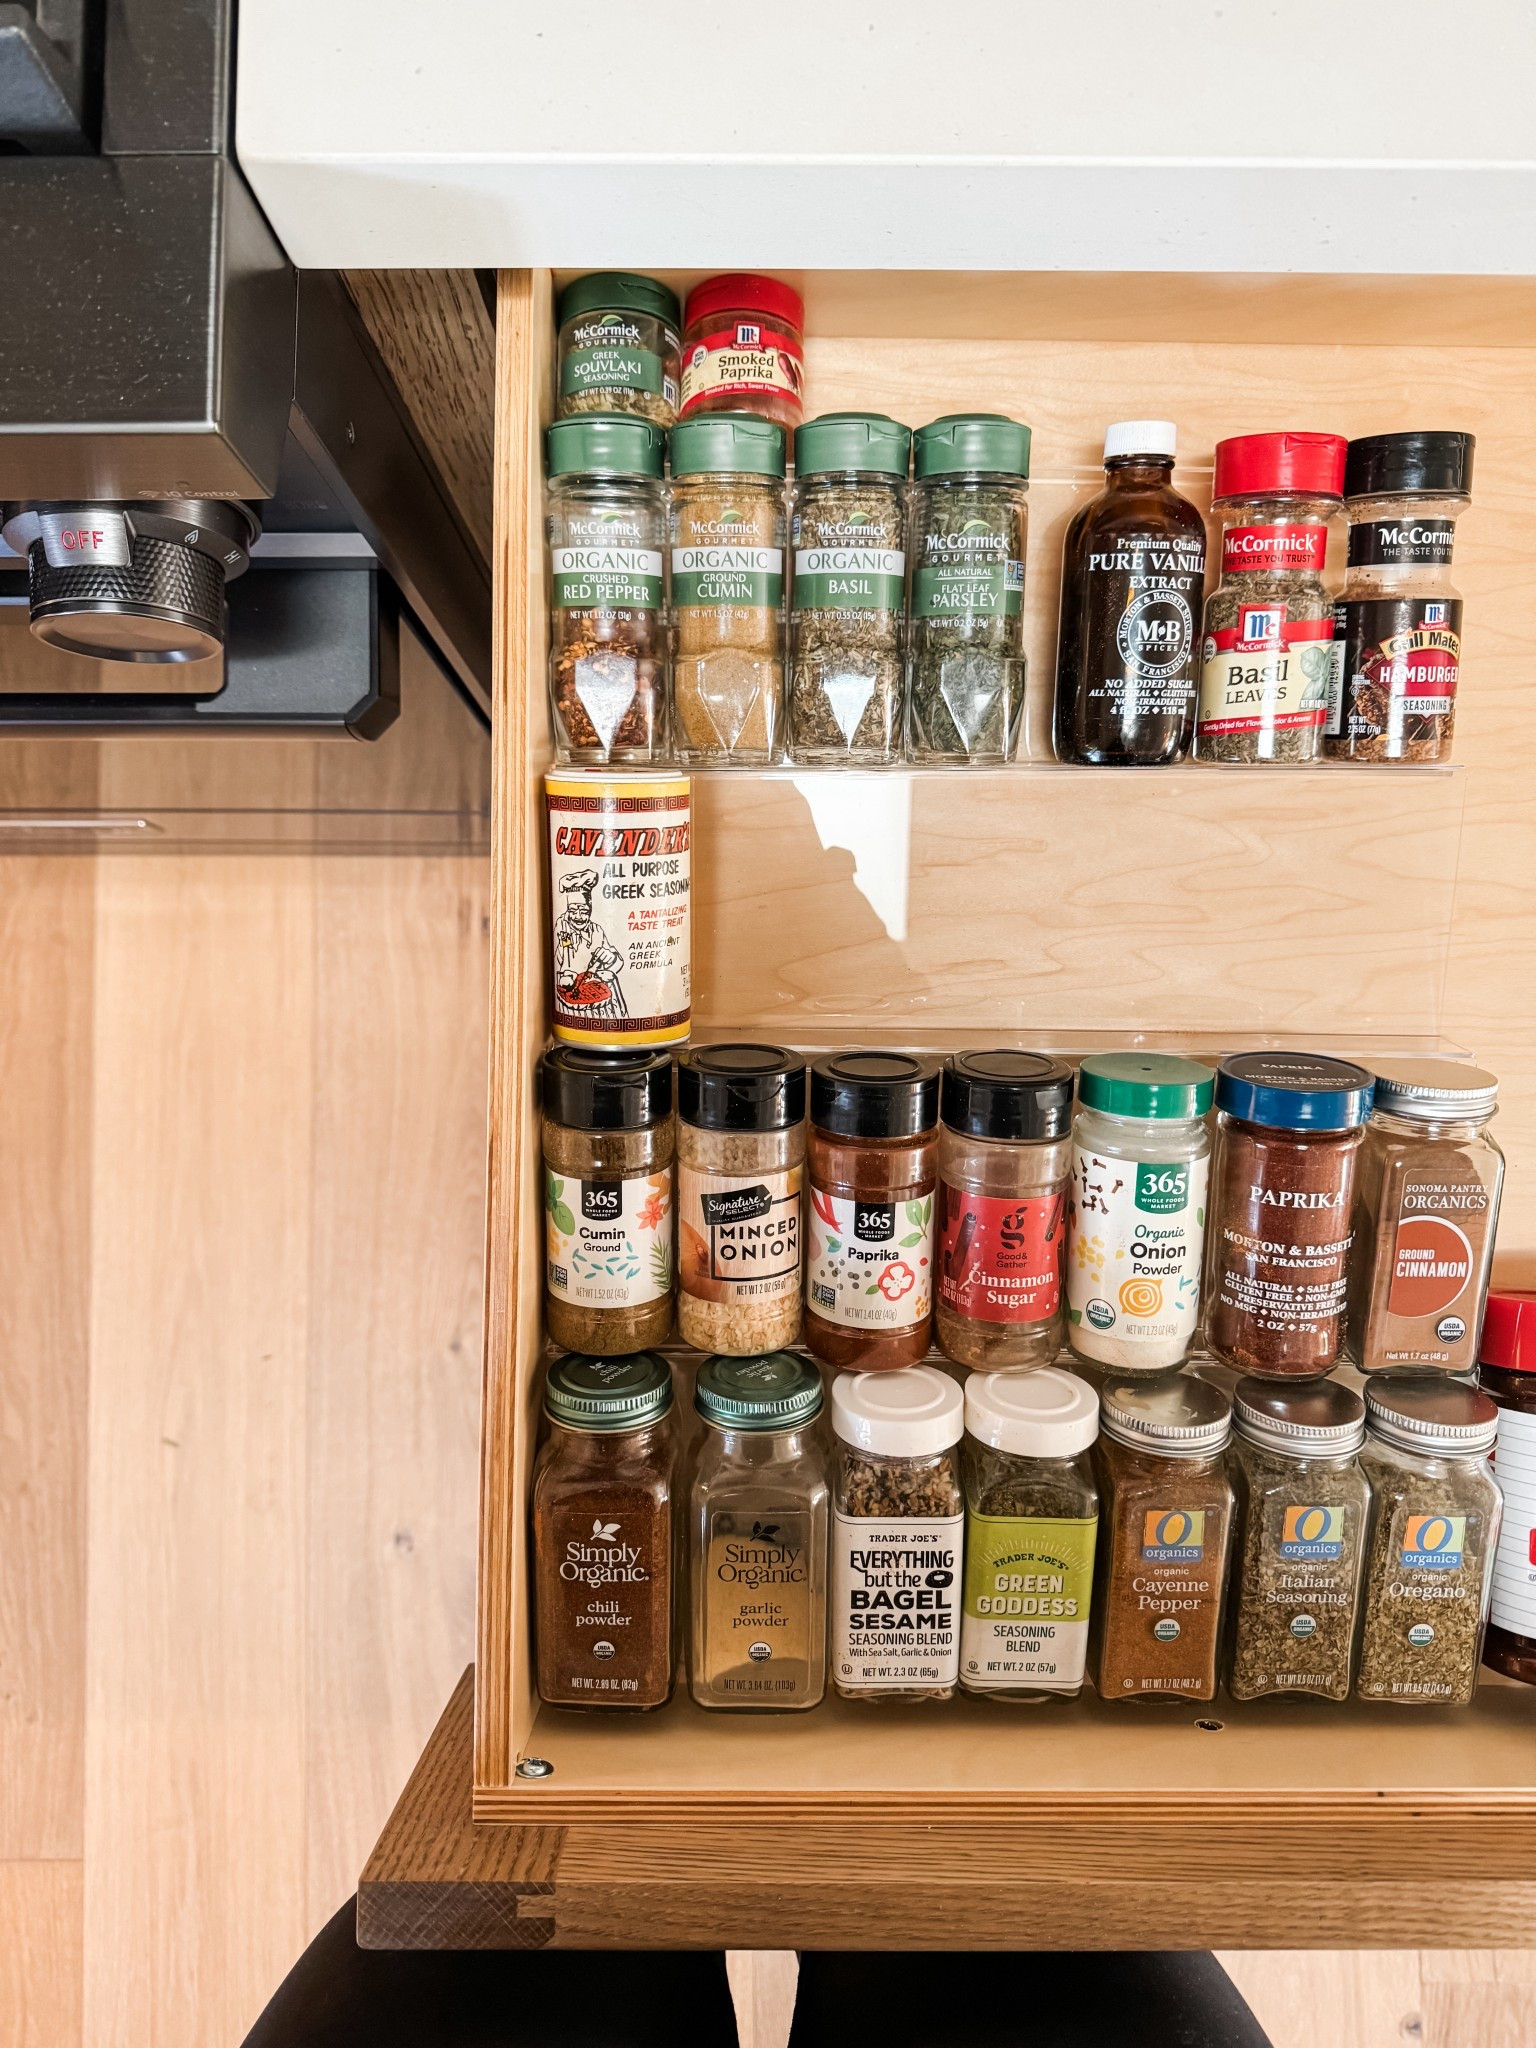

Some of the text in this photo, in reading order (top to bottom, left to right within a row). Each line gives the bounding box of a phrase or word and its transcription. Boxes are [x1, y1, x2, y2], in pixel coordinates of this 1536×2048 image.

[574, 322, 641, 341] McCormick
[593, 351, 619, 360] GREEK
[718, 353, 775, 368] Smoked
[574, 360, 642, 377] SOUVLAKI
[719, 366, 773, 382] Paprika
[583, 372, 630, 383] SEASONING
[570, 520, 641, 538] McCormick
[690, 520, 761, 536] McCormick
[817, 522, 888, 538] McCormick
[61, 531, 104, 550] OFF
[925, 533, 1010, 551] McCormick
[1117, 538, 1202, 555] Premium Quality
[1225, 533, 1315, 554] McCormick
[562, 552, 648, 571] ORGANIC
[682, 551, 768, 569] ORGANIC
[808, 553, 893, 571] ORGANIC
[1088, 553, 1205, 574] PURE VANILL
[1237, 556, 1262, 564] TASTE
[1264, 554, 1284, 563] YOU
[1286, 554, 1312, 562] TRUST
[582, 575, 629, 584] CRUSHED
[702, 573, 746, 583] GROUND
[937, 568, 992, 577] ALL NATURAL
[697, 583, 752, 598] CUMIN
[828, 579, 872, 594] BASIL
[942, 583, 990, 594] FLAT LEAF
[1129, 576, 1193, 589] EXTRACT
[563, 584, 649, 600] RED PEPPER
[932, 592, 998, 608] PARSLEY
[1236, 640, 1285, 651] McCormick
[1428, 632, 1459, 653] Mates
[1123, 650, 1140, 668] SAN
[1142, 651, 1187, 676] FRANCISCO
[1227, 660, 1289, 686] Basil
[1104, 679, 1124, 689] NO
[1126, 679, 1166, 689] ADDED
[1225, 686, 1287, 704] LEAVES
[1403, 700, 1447, 711] SEASONING
[602, 859, 679, 878] ALL PURPOSE
[602, 884, 645, 899] GREEK
[639, 904, 687, 919] TANTALIZING
[627, 916, 683, 931] TASTE TREAT
[629, 937, 680, 950] AN ANCIENT
[630, 951, 661, 960] GREEK
[629, 960, 673, 970] FORMULA
[1261, 1063, 1325, 1071] PAPRIKA
[1141, 1171, 1187, 1195] 365
[1405, 1184, 1489, 1193] SONOMA PANTRY
[585, 1190, 618, 1208] 365
[1250, 1185, 1345, 1209] PAPRIKA
[1403, 1194, 1487, 1209] ORGANICS
[708, 1195, 761, 1216] Signature
[725, 1203, 760, 1215] SELECT
[858, 1211, 891, 1229] 365
[579, 1227, 626, 1240] Cumin
[720, 1217, 796, 1240] MINCED
[1134, 1224, 1186, 1243] Organic
[583, 1242, 621, 1252] Ground
[720, 1234, 796, 1260] ONION
[1223, 1228, 1353, 1257] MORTON & BASSETT
[848, 1247, 900, 1263] Paprika
[1130, 1242, 1187, 1260] Onion
[1398, 1249, 1435, 1260] GROUND
[996, 1261, 1027, 1269] Gather
[1245, 1252, 1338, 1268] SAN FRANCISCO
[1133, 1262, 1183, 1276] Powder
[1396, 1261, 1467, 1278] CINNAMON
[970, 1270, 1054, 1289] Cinnamon
[1225, 1270, 1347, 1293] ALL NATURAL SALT FREE
[986, 1290, 1037, 1309] Sugar
[869, 1534, 939, 1543] TRADER JOE'S
[567, 1541, 642, 1569] Simply
[725, 1543, 801, 1569] Simply
[1146, 1547, 1199, 1561] organics
[1284, 1543, 1337, 1557] organics
[850, 1550, 954, 1573] EVERYTHING
[992, 1553, 1068, 1571] TRADER JOE'S
[1404, 1552, 1458, 1567] organics
[1153, 1566, 1190, 1576] organic
[1291, 1563, 1328, 1573] organic
[864, 1569, 922, 1588] but the
[994, 1573, 1064, 1594] GREEN
[1281, 1575, 1335, 1589] Italian
[1411, 1573, 1449, 1582] organic
[1132, 1577, 1209, 1595] Cayenne
[1389, 1582, 1466, 1601] Oregano
[850, 1589, 952, 1610] BAGEL
[976, 1595, 1078, 1617] GODDESS
[1137, 1595, 1203, 1613] Pepper
[1266, 1590, 1348, 1606] Seasoning
[587, 1601, 620, 1613] chili
[739, 1602, 782, 1616] garlic
[575, 1614, 633, 1627] powder
[732, 1615, 789, 1629] powder
[849, 1613, 952, 1630] SESAME
[848, 1632, 953, 1646] SEASONING BLEND
[993, 1625, 1055, 1639] SEASONING
[849, 1648, 868, 1657] With
[868, 1648, 882, 1657] Sea
[883, 1648, 900, 1659] Salt,
[901, 1647, 923, 1657] Garlic
[930, 1648, 952, 1657] Onion
[1006, 1641, 1041, 1653] BLEND
[862, 1667, 939, 1679] NET WT. 2.3 OZ (65g)
